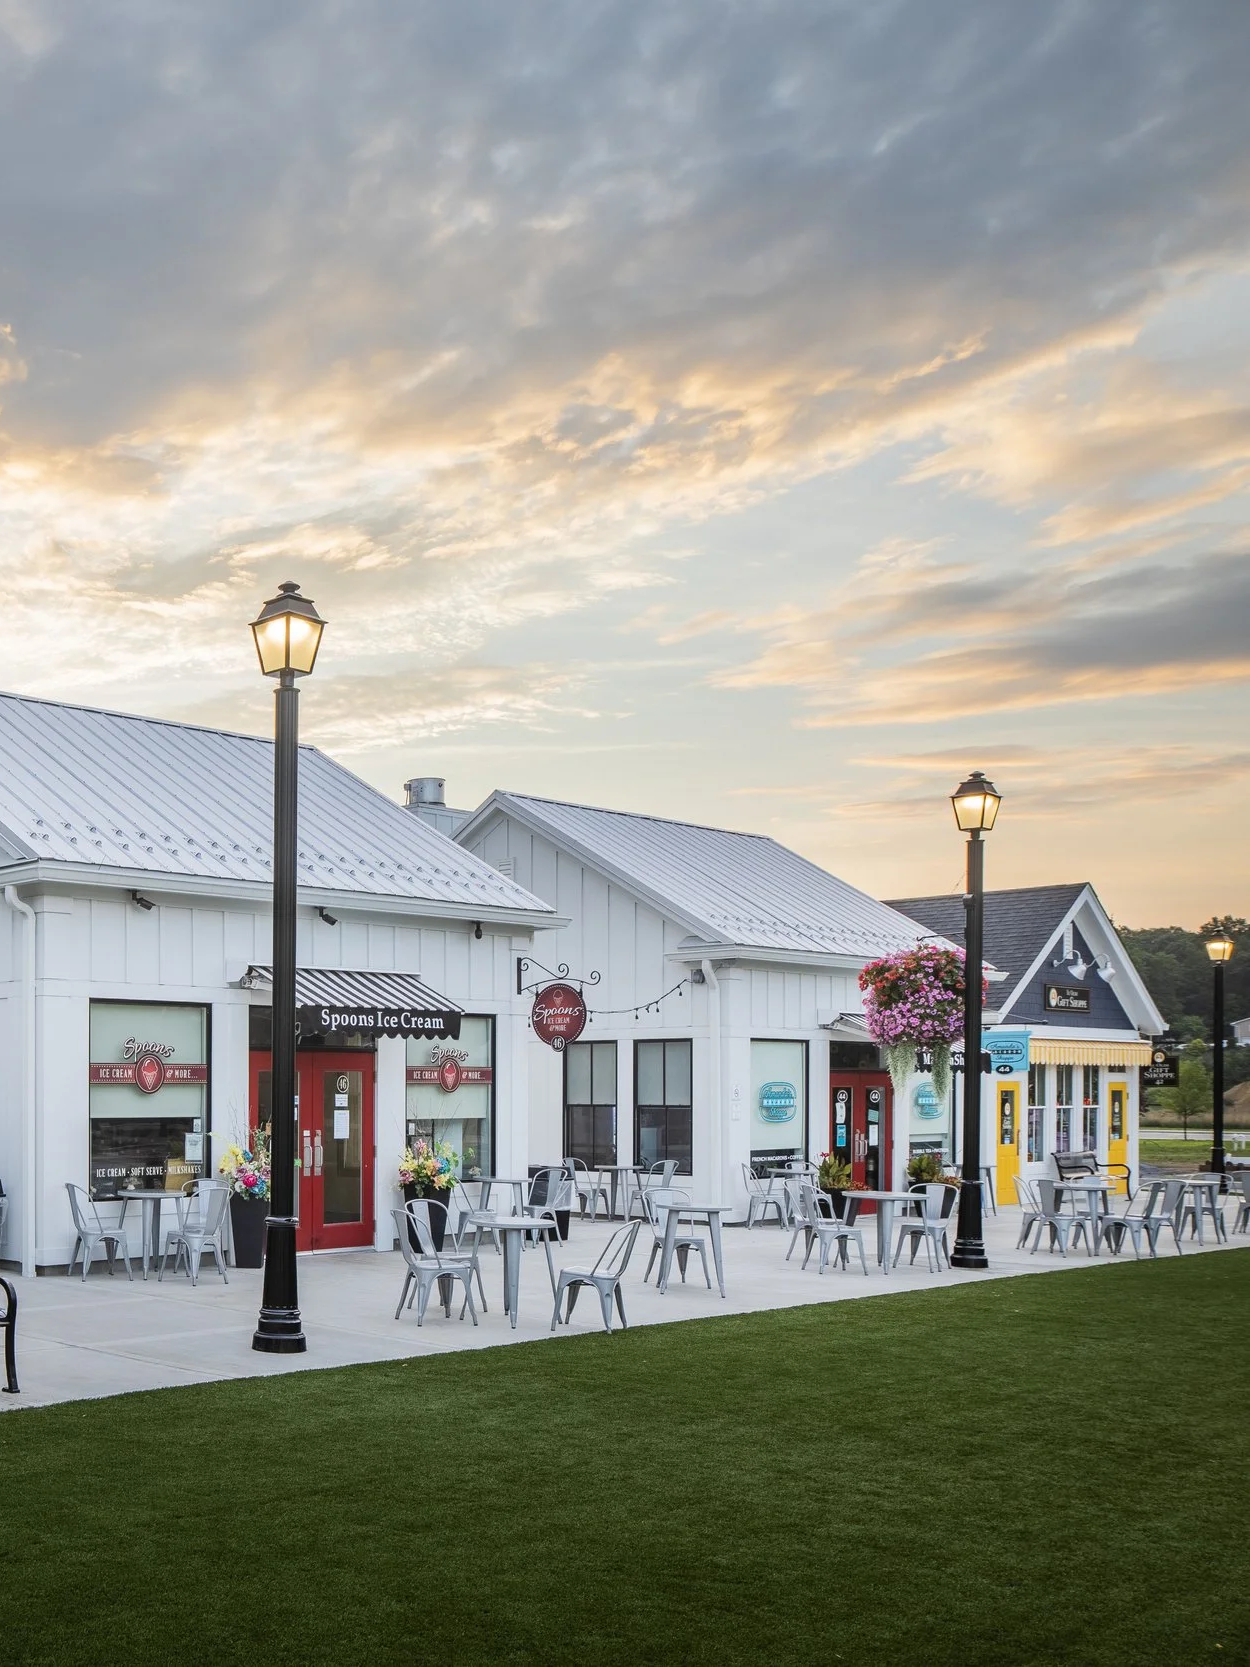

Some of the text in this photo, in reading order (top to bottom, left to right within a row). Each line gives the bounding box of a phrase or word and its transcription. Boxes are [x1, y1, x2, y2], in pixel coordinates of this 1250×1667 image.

[321, 1009, 445, 1030] Spoons Ice Cream
[533, 1004, 583, 1025] Spoons
[547, 1017, 555, 1025] ICE
[123, 1036, 175, 1062] Spoons
[553, 1038, 562, 1049] 46
[430, 1044, 469, 1066] Spoons
[99, 1068, 133, 1078] ICE CREAM
[413, 1071, 438, 1079] ICE CREAM
[339, 1078, 347, 1090] 46
[96, 1165, 202, 1178] ICE CREAM SOFT SERVE MILKSHAKES
